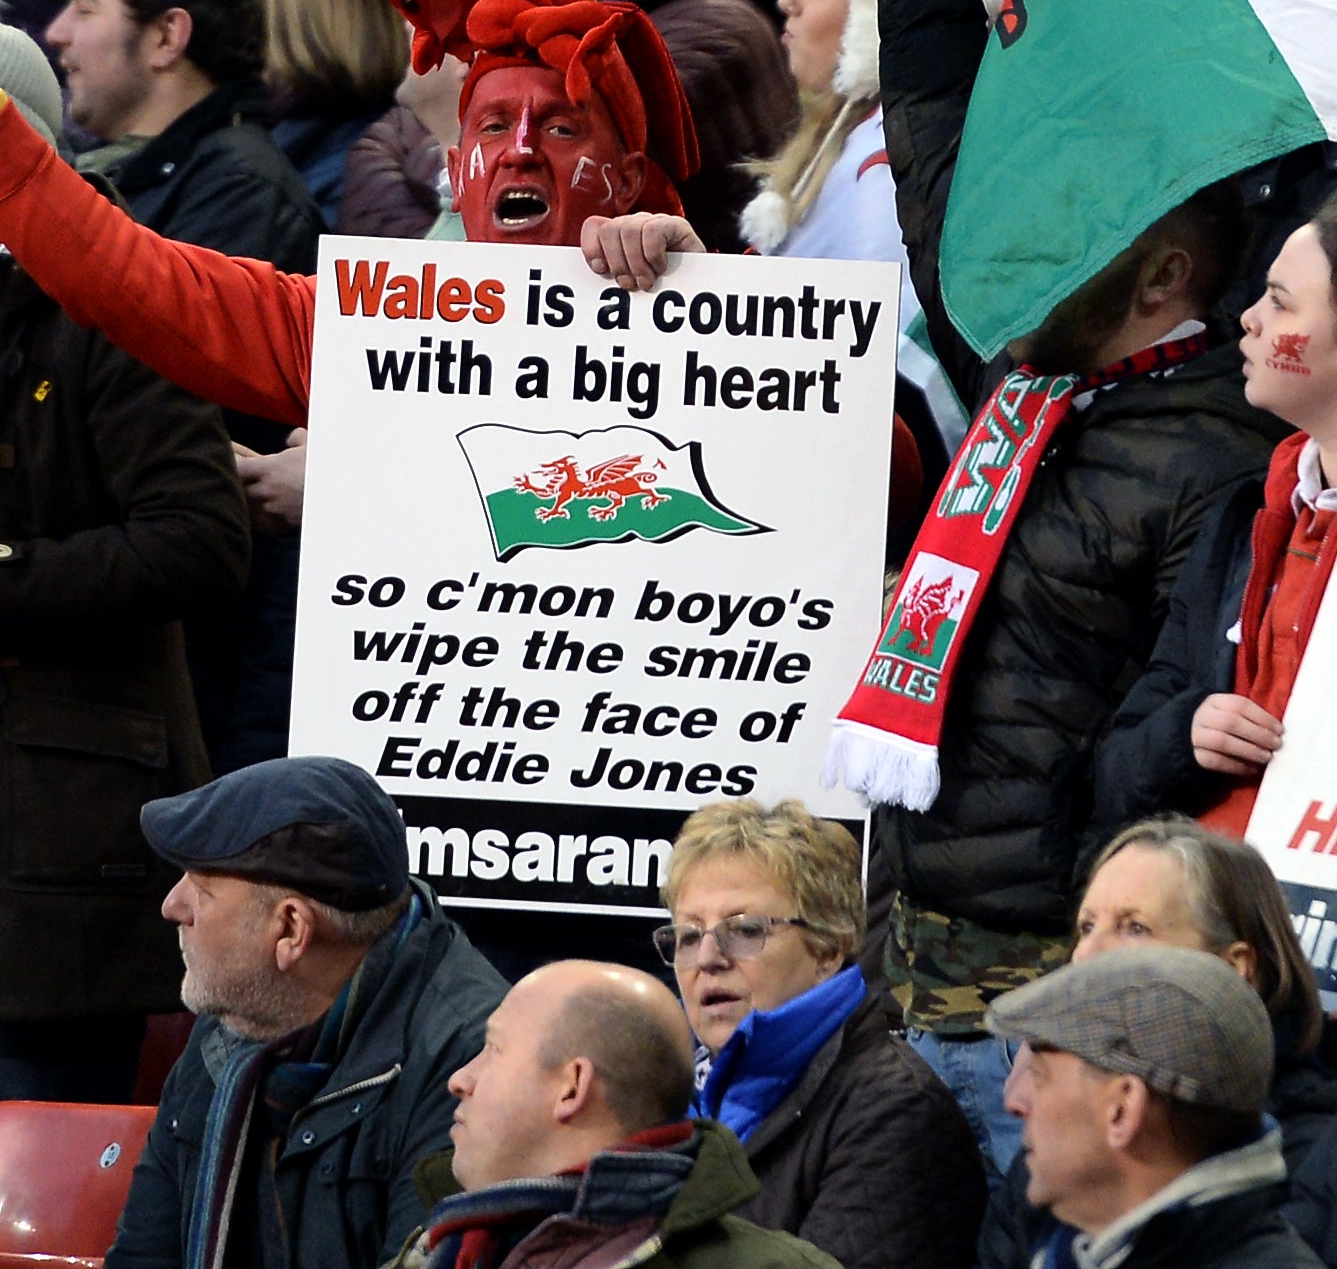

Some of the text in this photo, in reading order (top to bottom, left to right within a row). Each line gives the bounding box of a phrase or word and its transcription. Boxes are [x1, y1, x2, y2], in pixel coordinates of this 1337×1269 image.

[334, 259, 882, 358] Wales is a country
[365, 336, 842, 420] with a big heart
[331, 572, 834, 636] so c'mon boyo's
[353, 622, 811, 684] wipe the smile
[352, 681, 807, 743] off the face of
[375, 736, 758, 797] Eddie Jones
[399, 809, 674, 888] msaran
